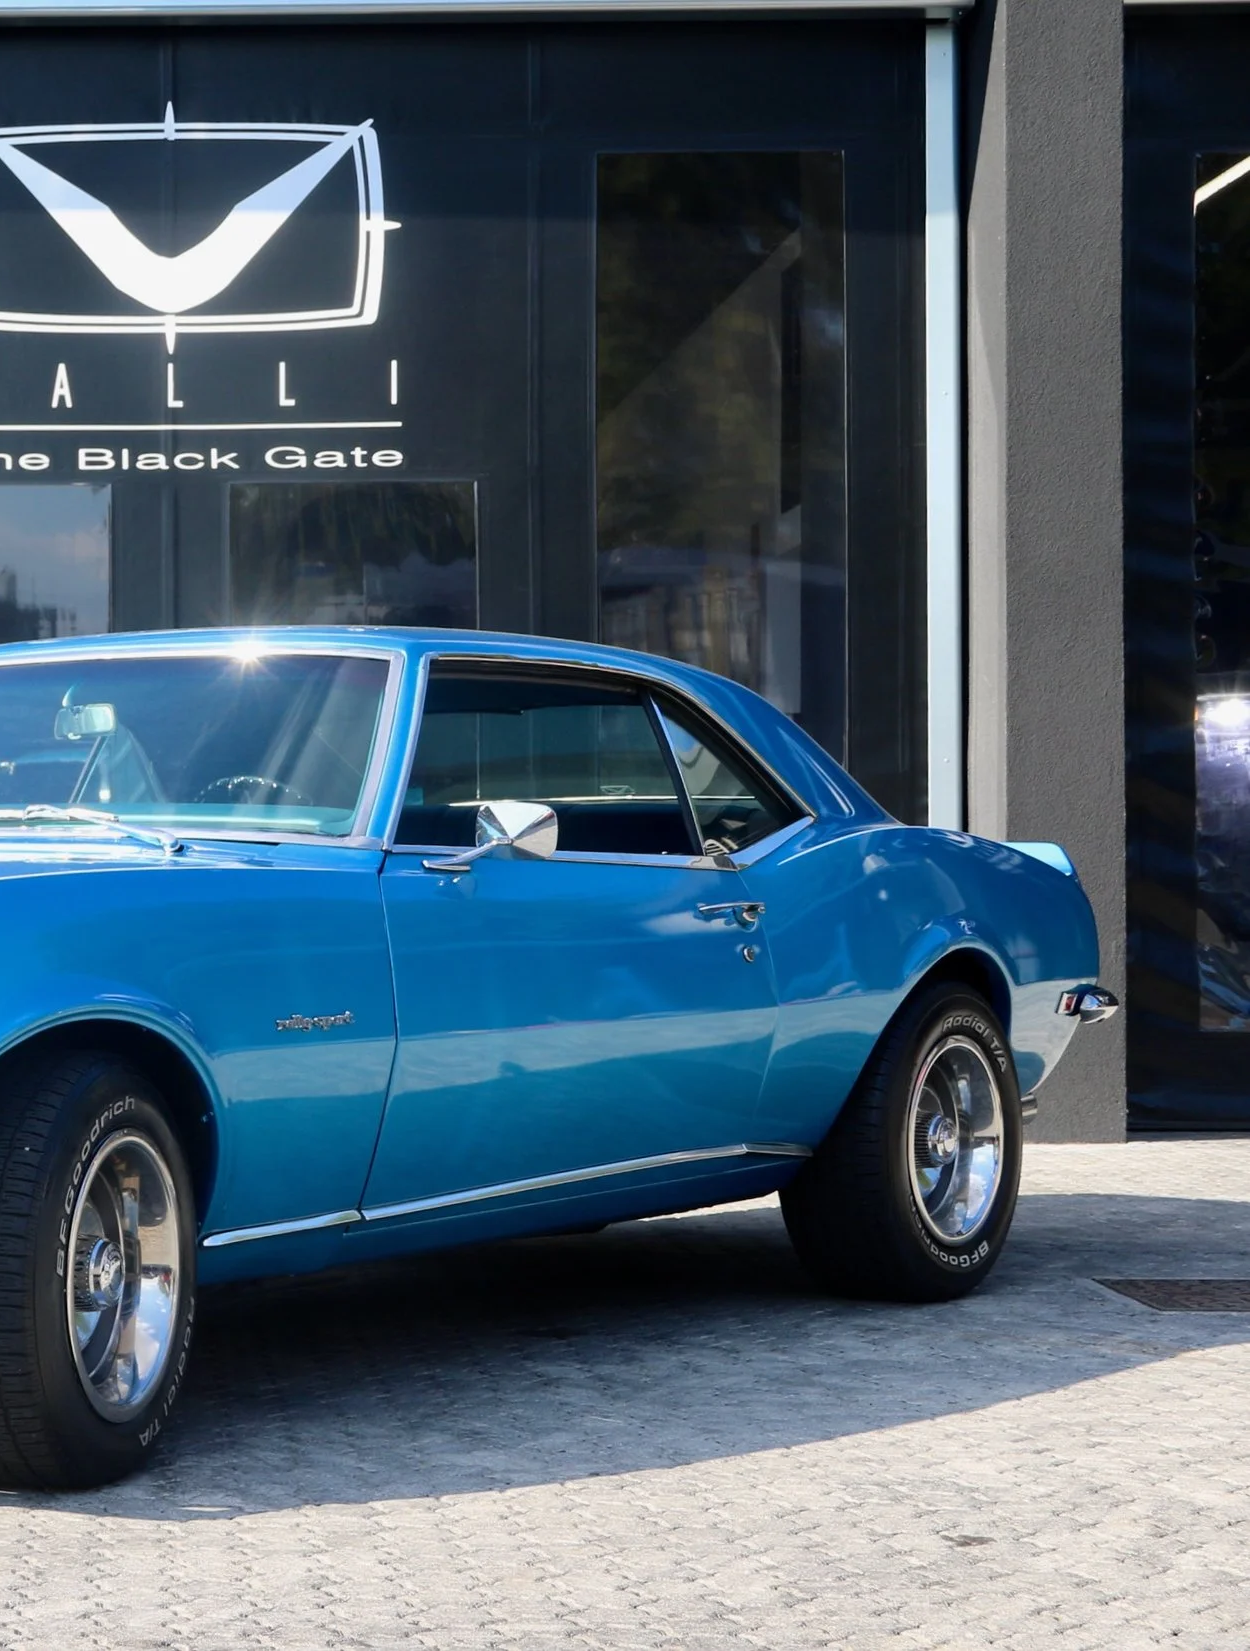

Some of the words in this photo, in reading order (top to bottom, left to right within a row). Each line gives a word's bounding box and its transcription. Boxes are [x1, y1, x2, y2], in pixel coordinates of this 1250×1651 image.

[78, 447, 239, 470] Black
[264, 446, 404, 469] Gate
[943, 1015, 990, 1038] Radial
[990, 1036, 1008, 1073] T/A
[56, 1095, 136, 1277] BFGoodrich
[909, 1194, 990, 1268] BFGoodrich
